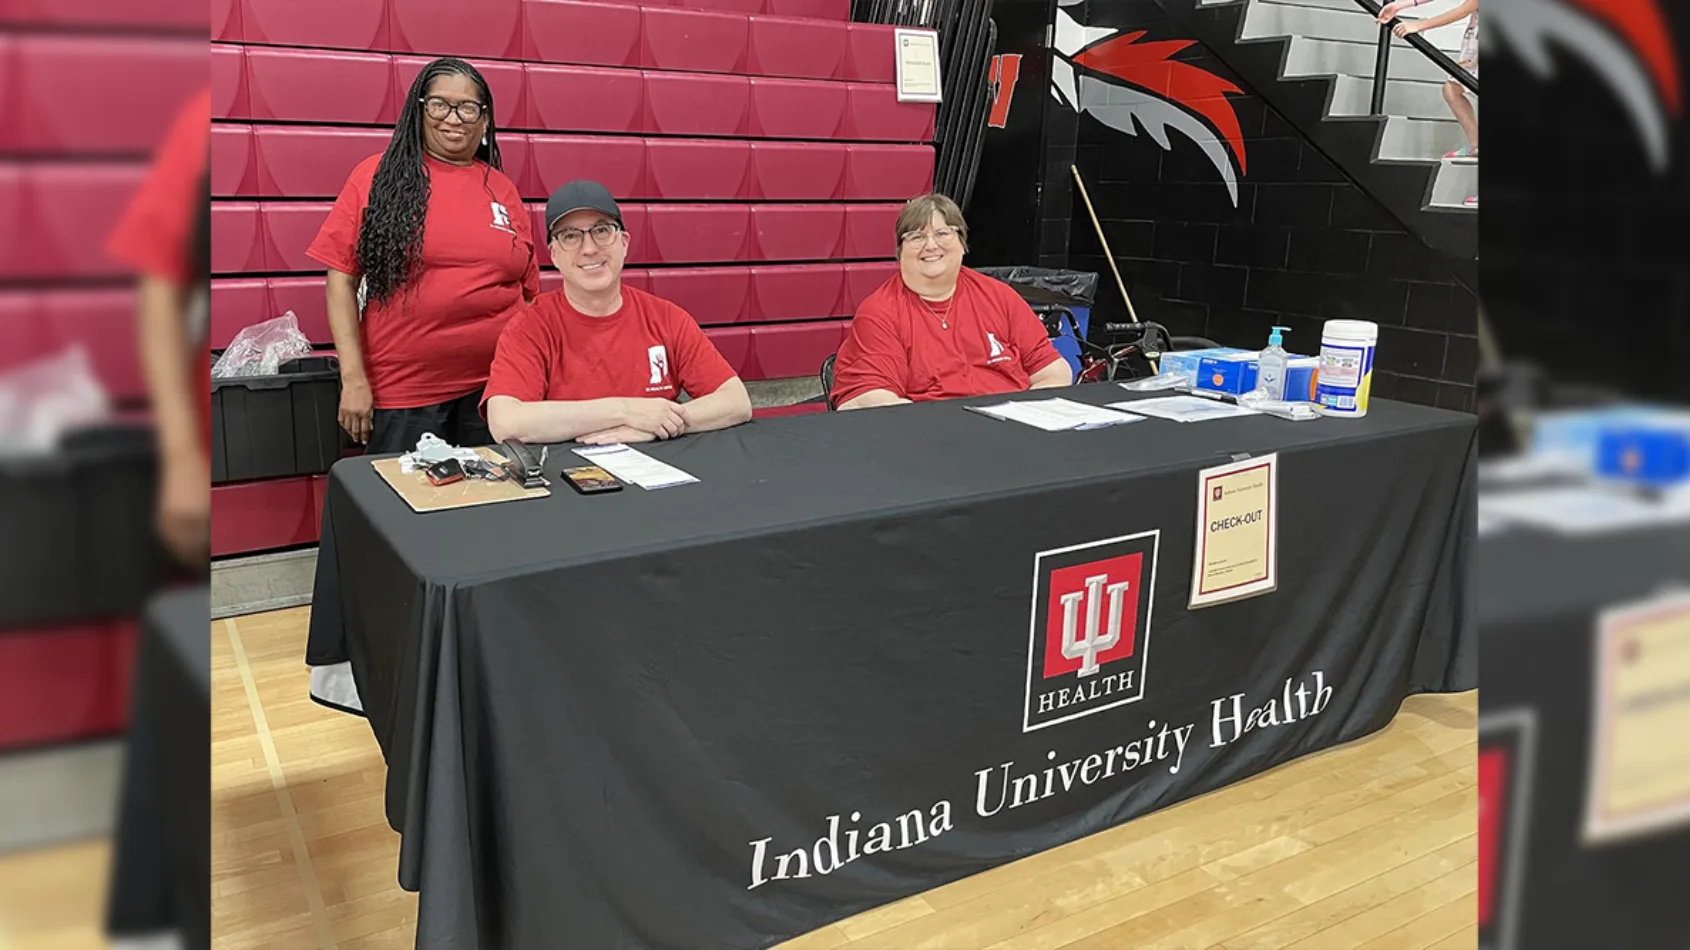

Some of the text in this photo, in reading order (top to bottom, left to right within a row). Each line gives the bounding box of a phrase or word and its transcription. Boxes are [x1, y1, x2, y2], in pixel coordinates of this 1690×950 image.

[1210, 509, 1263, 533] CHECK-OUT
[1037, 670, 1135, 714] HEALTH
[747, 671, 1334, 890] Indiana University Health
